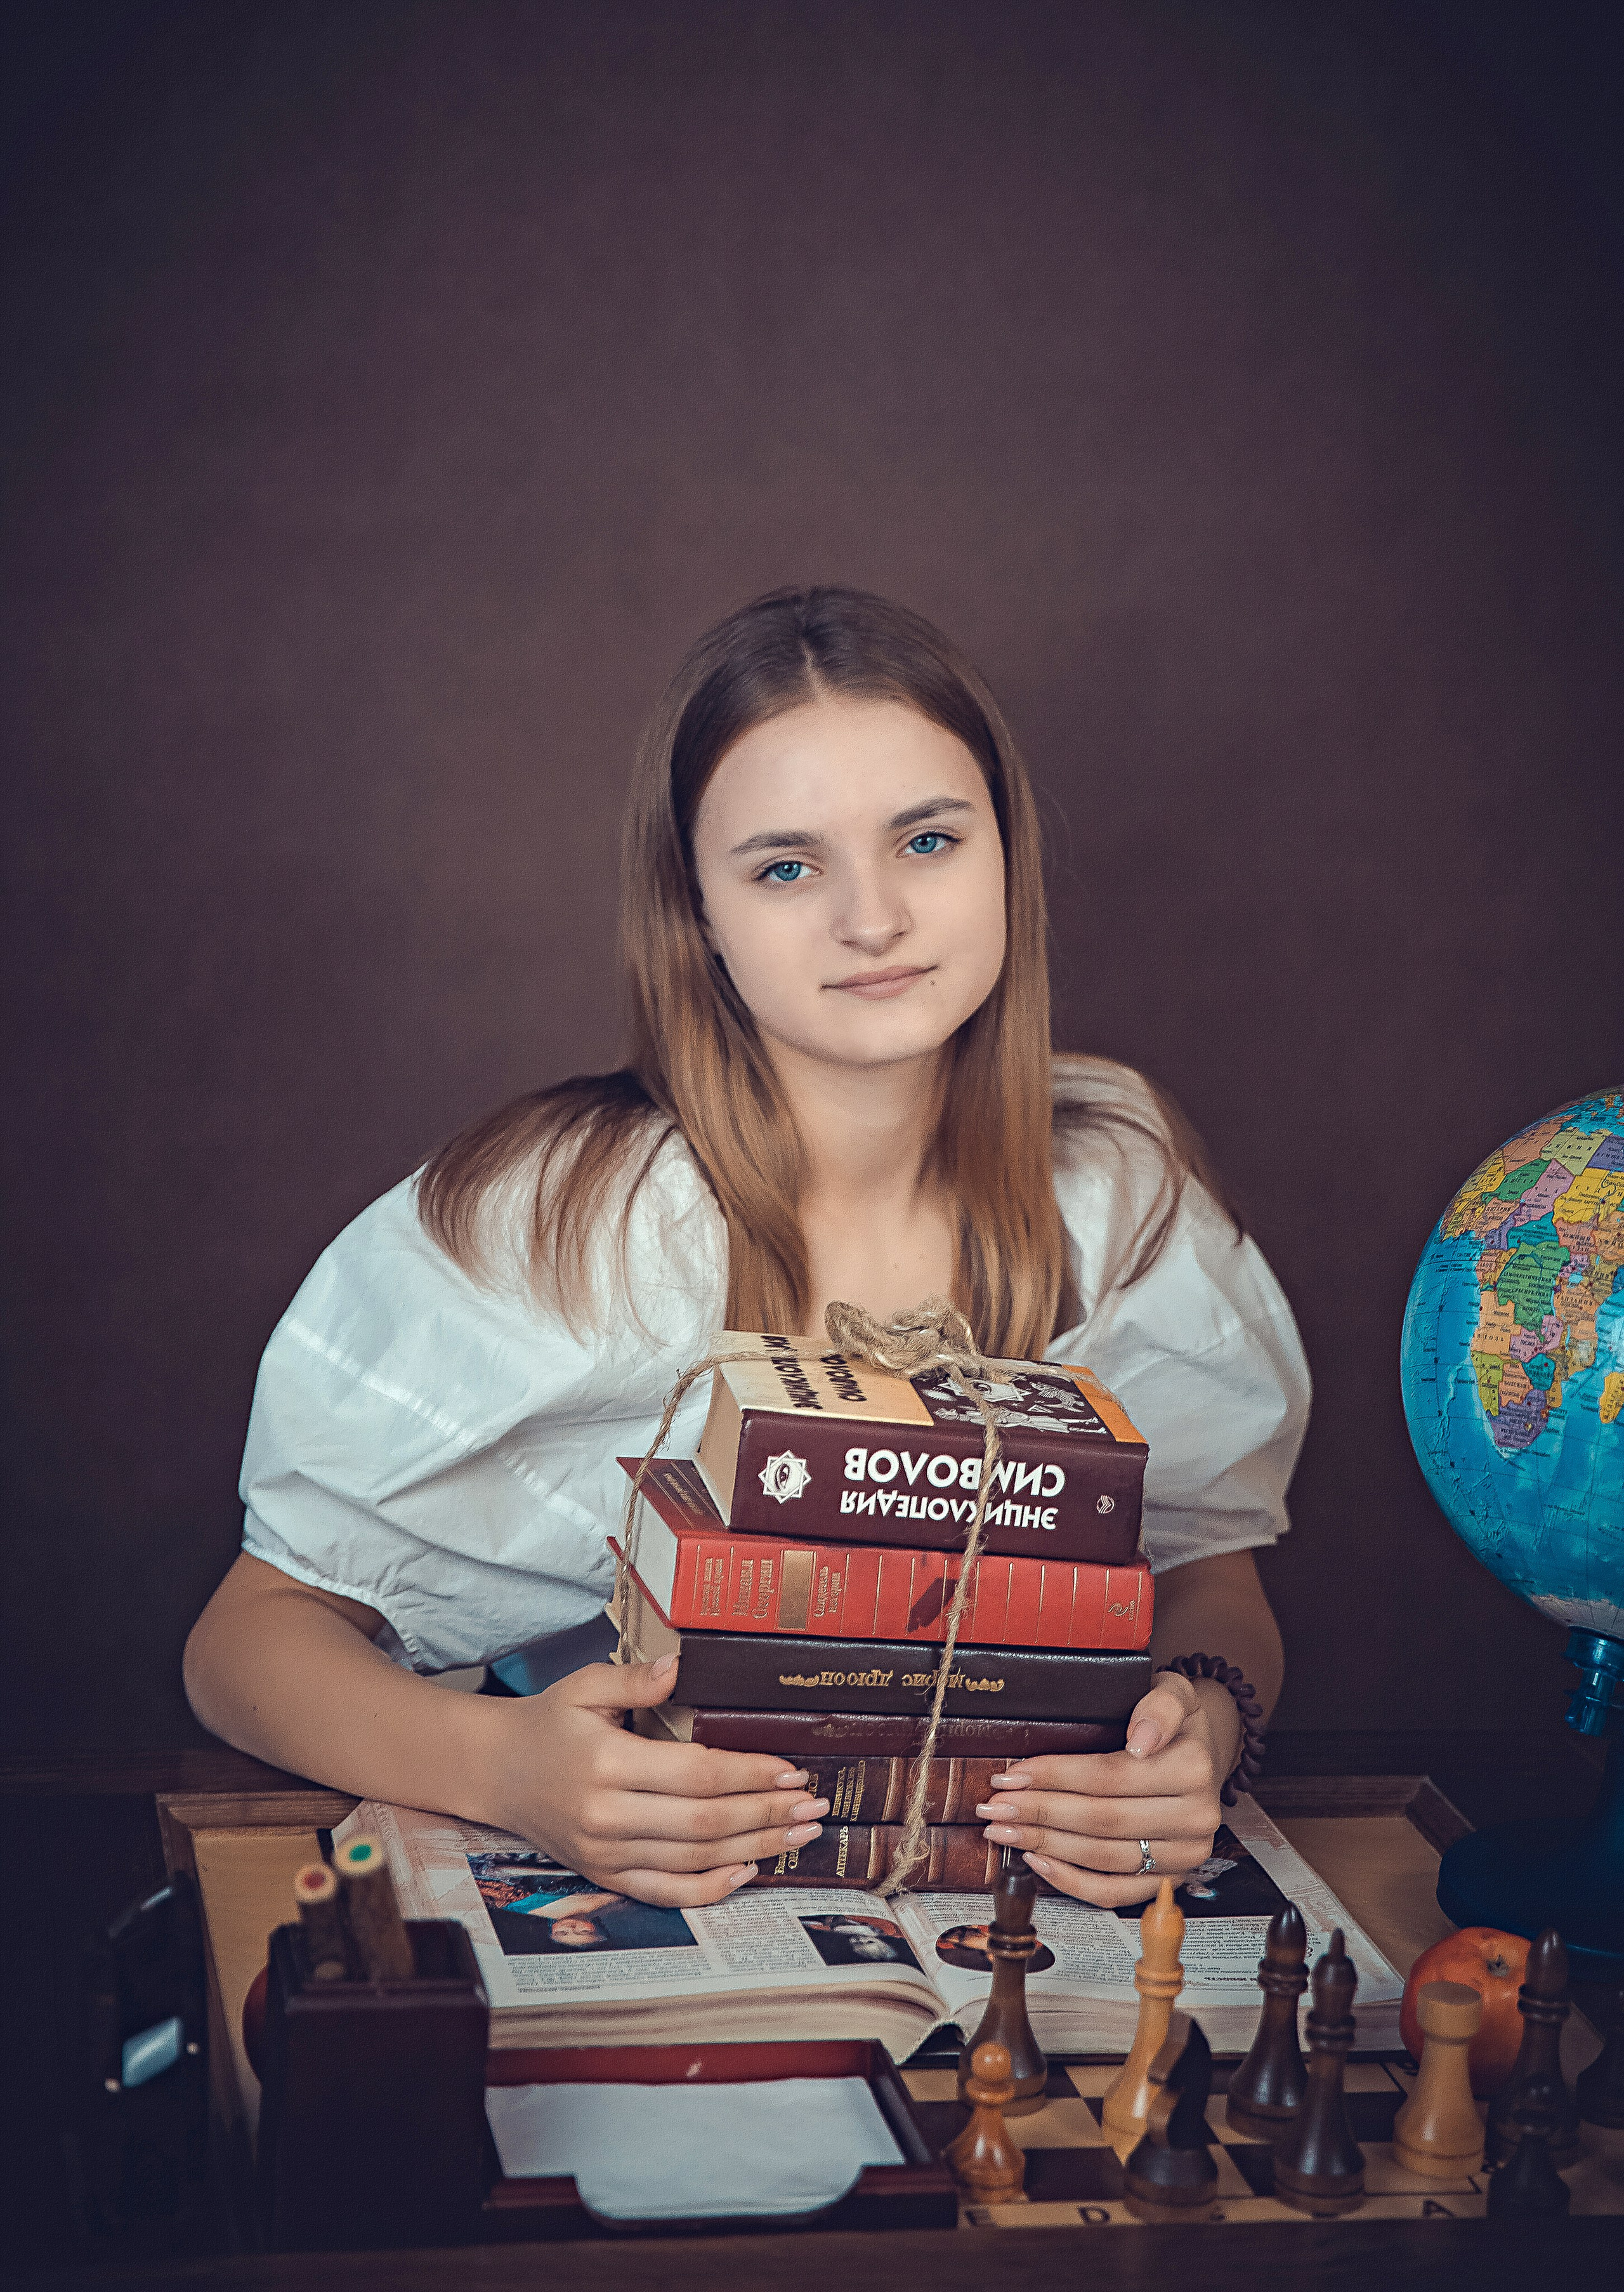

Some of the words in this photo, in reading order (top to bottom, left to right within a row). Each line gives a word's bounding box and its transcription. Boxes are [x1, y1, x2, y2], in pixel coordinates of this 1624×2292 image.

[843, 1446, 1066, 1498] СИМВОЛОВ
[839, 1488, 1059, 1531] ЭНЦИКЛОПЕДИЯ
[818, 1669, 894, 1687] дрюон
[901, 1669, 966, 1688] мрис
[835, 1826, 849, 1878] АПТЕКАРЬ
